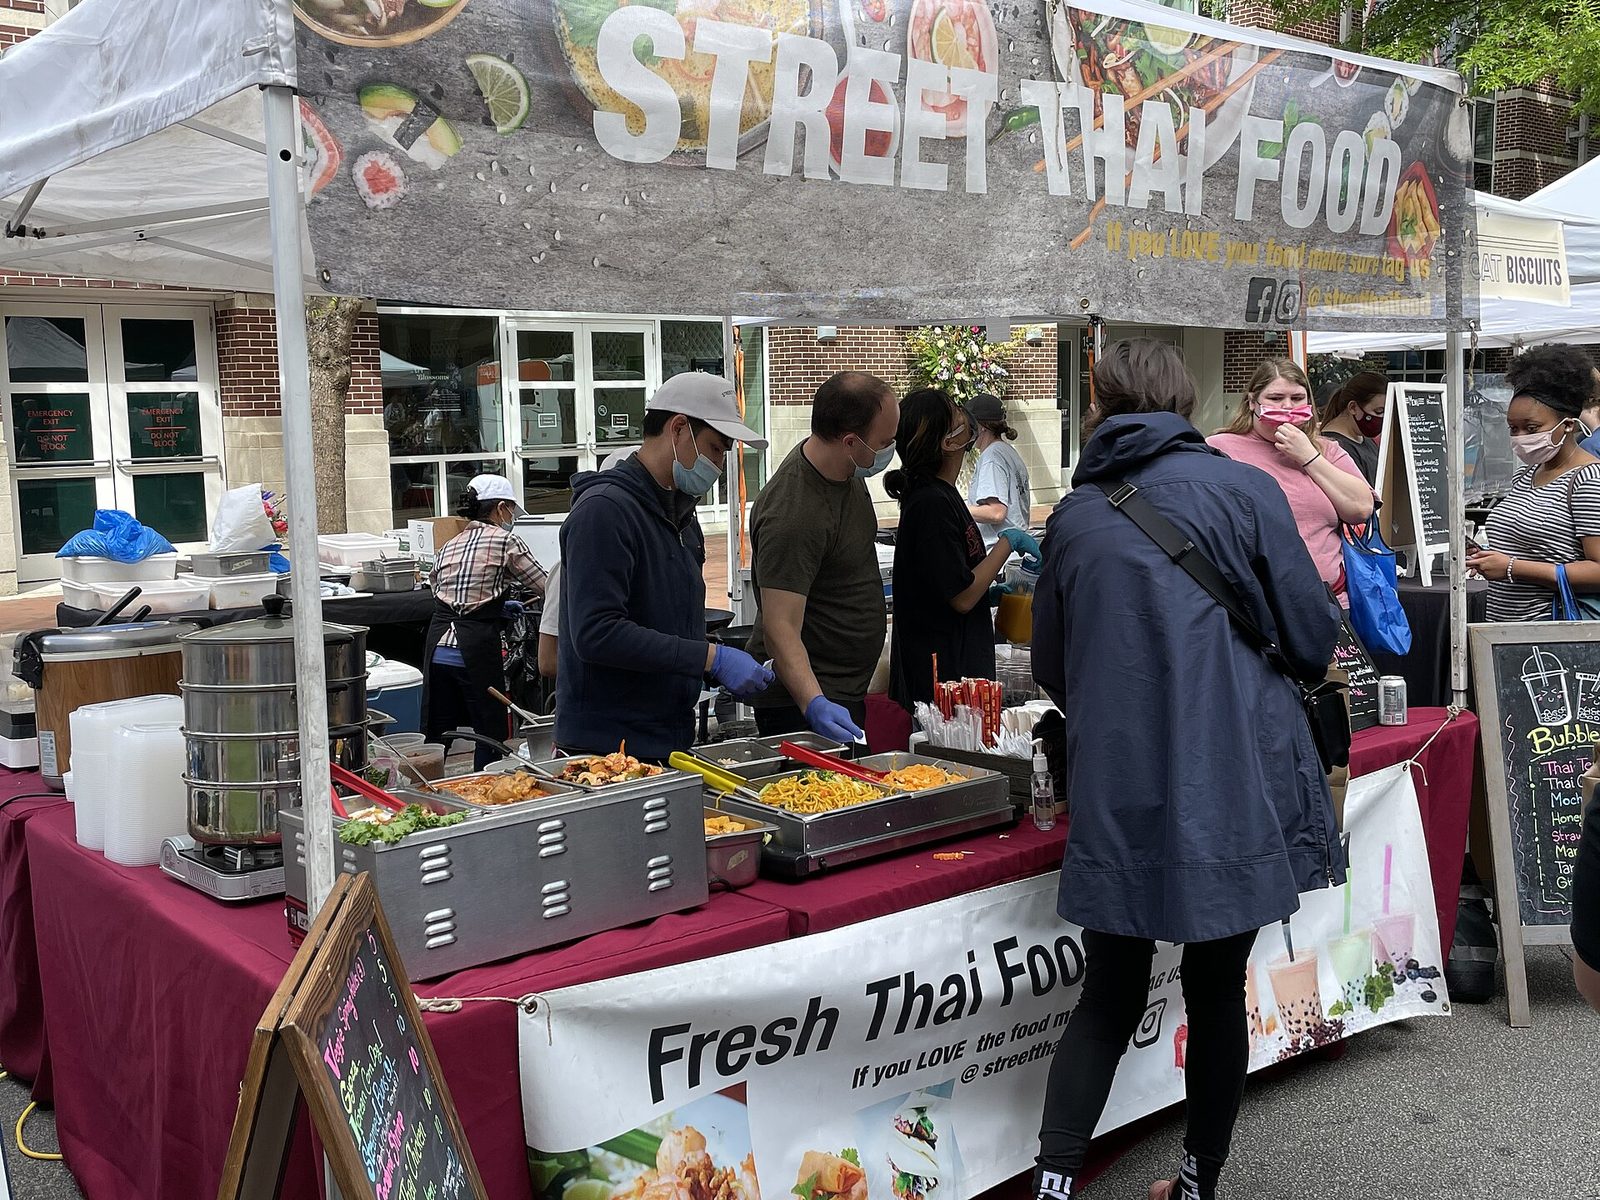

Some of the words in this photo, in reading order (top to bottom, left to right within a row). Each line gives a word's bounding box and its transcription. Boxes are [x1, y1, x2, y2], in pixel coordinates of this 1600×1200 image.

[594, 5, 999, 194] STREET
[1020, 78, 1206, 216] THAI
[1234, 115, 1402, 236] FOOD
[1169, 226, 1220, 262] LOVE
[1308, 248, 1347, 273] make
[1349, 254, 1380, 275] sure
[1381, 251, 1405, 283] tag
[1409, 258, 1431, 281] us
[1506, 255, 1563, 286] BISCUITS
[27, 409, 74, 417] EMERGENCY
[42, 418, 60, 426] EXIT
[142, 408, 185, 416] EMERGENCY
[156, 416, 172, 424] EXIT
[37, 435, 50, 443] DO
[51, 434, 68, 442] NOT
[40, 443, 66, 451] BLOCK
[150, 432, 163, 440] DO
[163, 432, 180, 440] NOT
[153, 439, 177, 448] BLOCK
[1526, 724, 1600, 755] Bubble
[1541, 761, 1575, 777] Thai
[1576, 758, 1593, 771] Te
[1543, 777, 1575, 790] Thai
[1550, 792, 1583, 809] Moch
[366, 928, 378, 955] 5
[376, 958, 388, 984] 5
[387, 985, 398, 1008] 5
[396, 1014, 406, 1035] 10
[646, 995, 841, 1105] Fresh
[864, 948, 982, 1043] Thai
[992, 934, 1087, 1008] Foo
[408, 1045, 420, 1075] 10
[851, 1065, 870, 1090] If
[871, 1058, 912, 1088] you
[915, 1039, 967, 1071] LOVE
[975, 1031, 1005, 1053] the
[1009, 1013, 1051, 1043] food
[982, 1038, 1061, 1078] streettha
[422, 1087, 432, 1111] 10
[433, 1114, 443, 1143] 10
